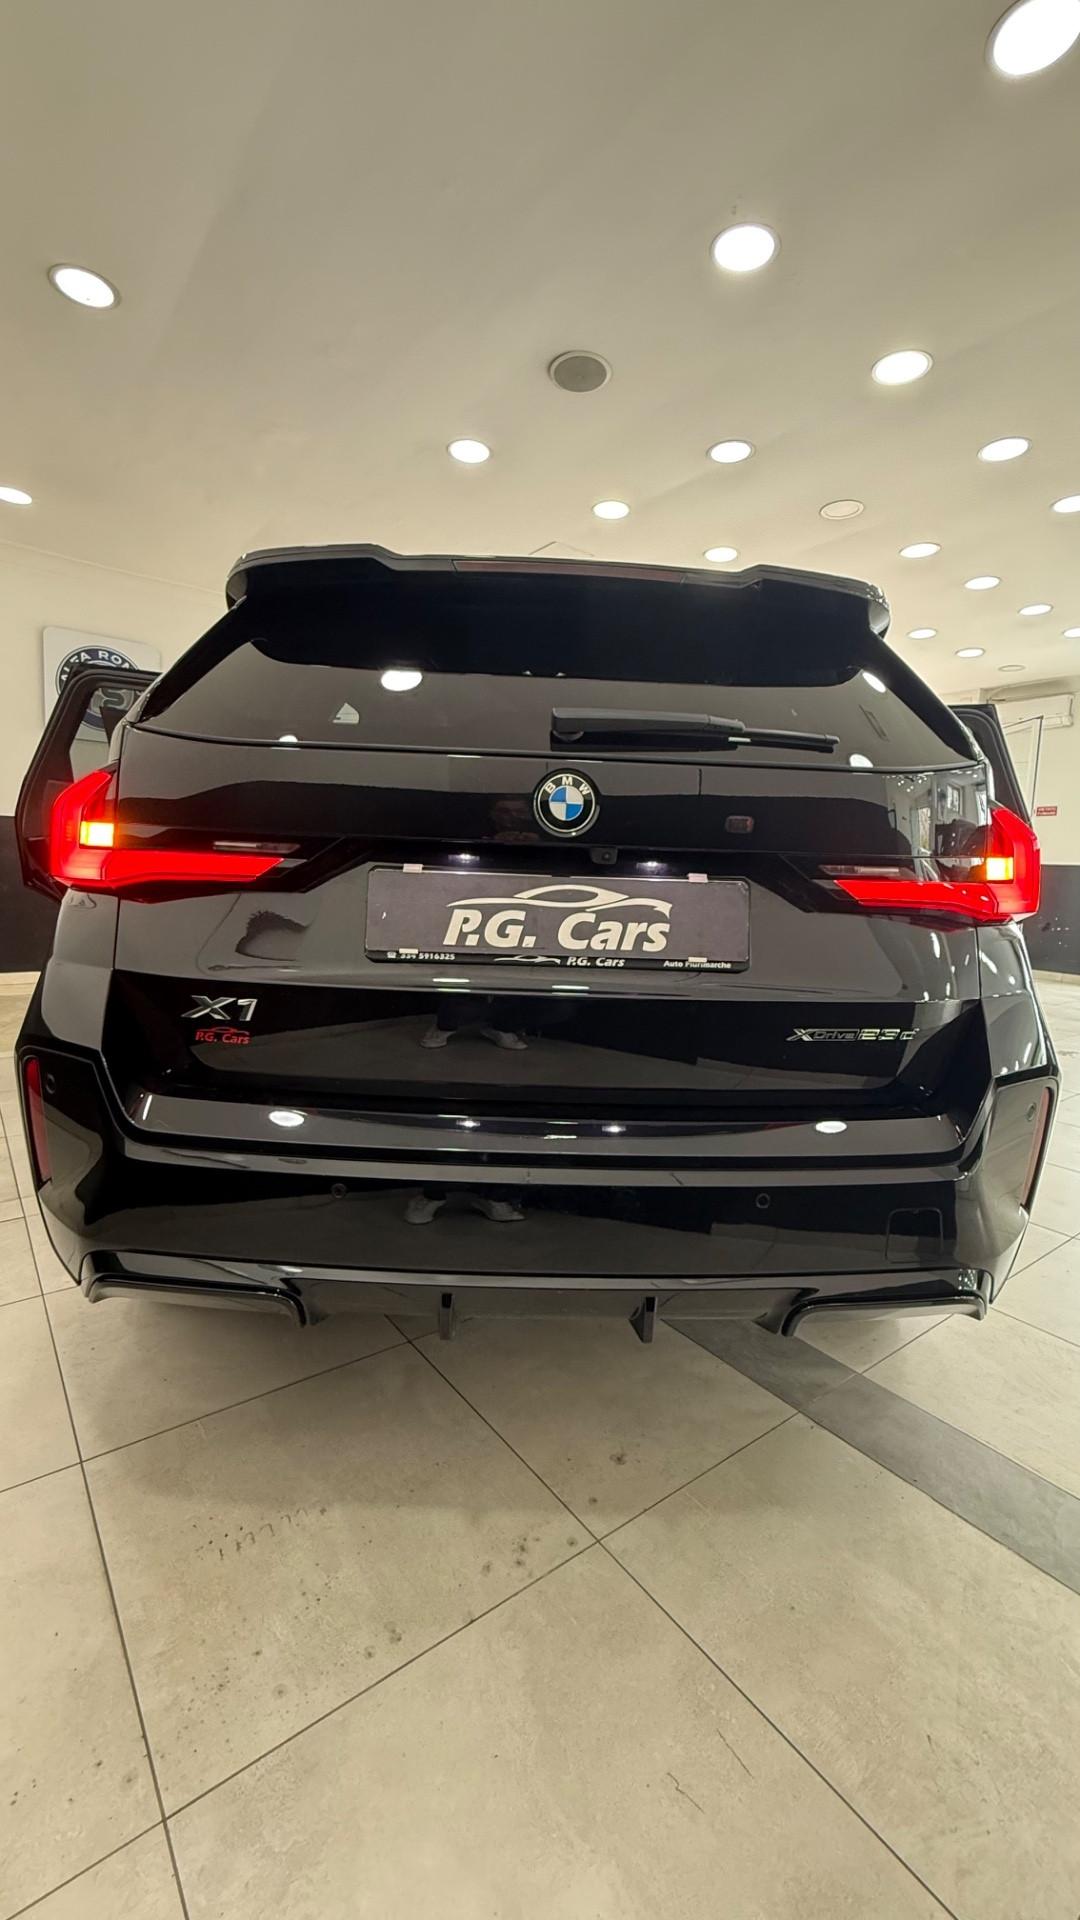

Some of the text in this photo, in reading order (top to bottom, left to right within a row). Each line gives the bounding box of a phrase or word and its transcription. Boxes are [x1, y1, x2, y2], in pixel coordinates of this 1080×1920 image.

[545, 776, 592, 796] BMW
[443, 909, 671, 952] P.G. Cars
[566, 956, 626, 967] P.G. Cars
[663, 960, 683, 968] Auto
[180, 994, 258, 1021] X1
[195, 1031, 251, 1044] P.G. Cars
